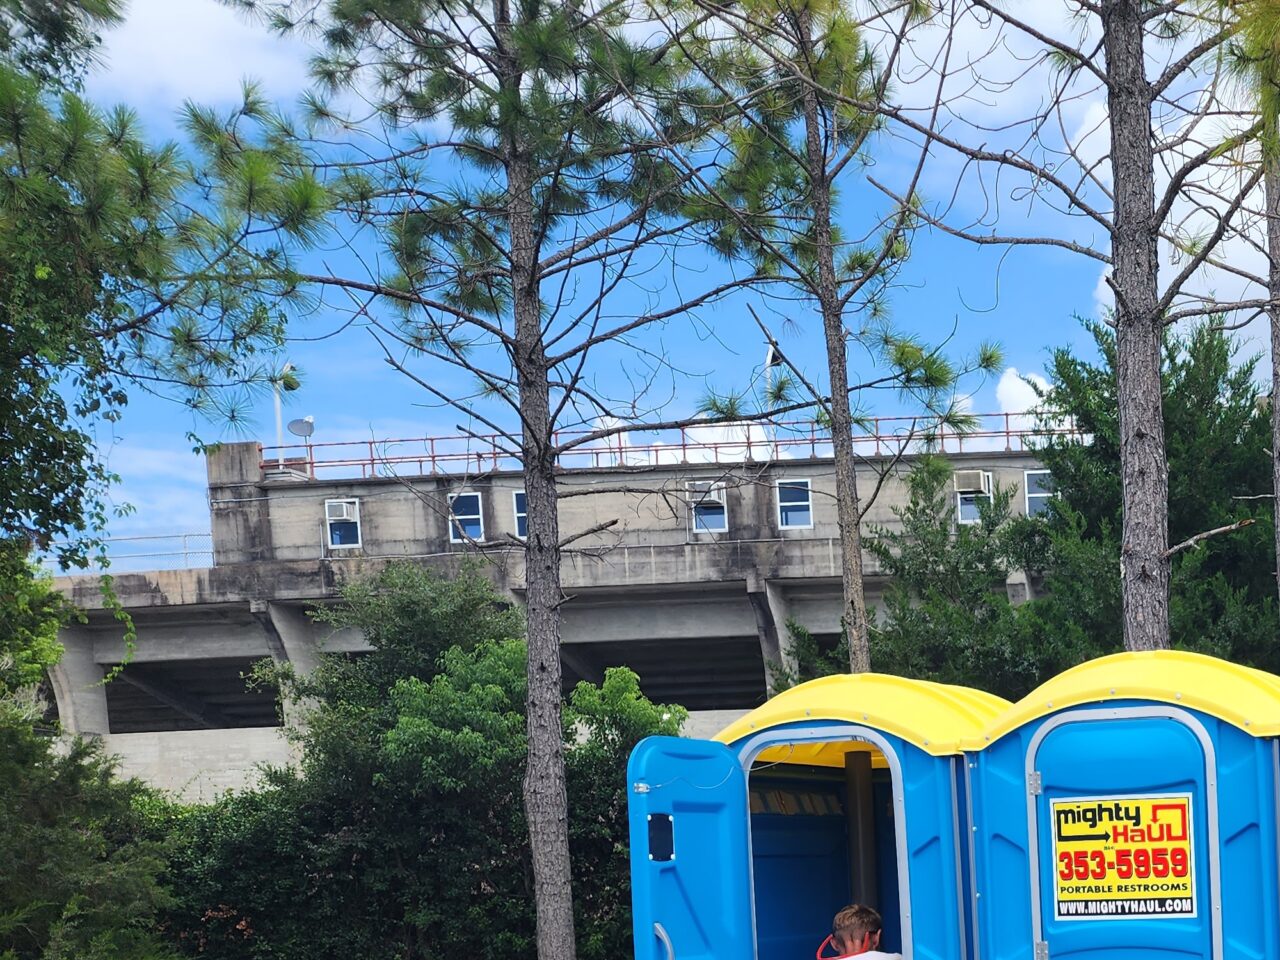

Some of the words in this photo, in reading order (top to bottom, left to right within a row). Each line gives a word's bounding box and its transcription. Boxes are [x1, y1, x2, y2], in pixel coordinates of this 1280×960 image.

[1056, 803, 1141, 828] mighty
[1059, 848, 1188, 881] 353-5959
[1060, 885, 1113, 894] PORTABLE
[1117, 883, 1188, 893] RESTROOMS
[1059, 899, 1192, 914] WWW.MIGHTYHAUL.COM
